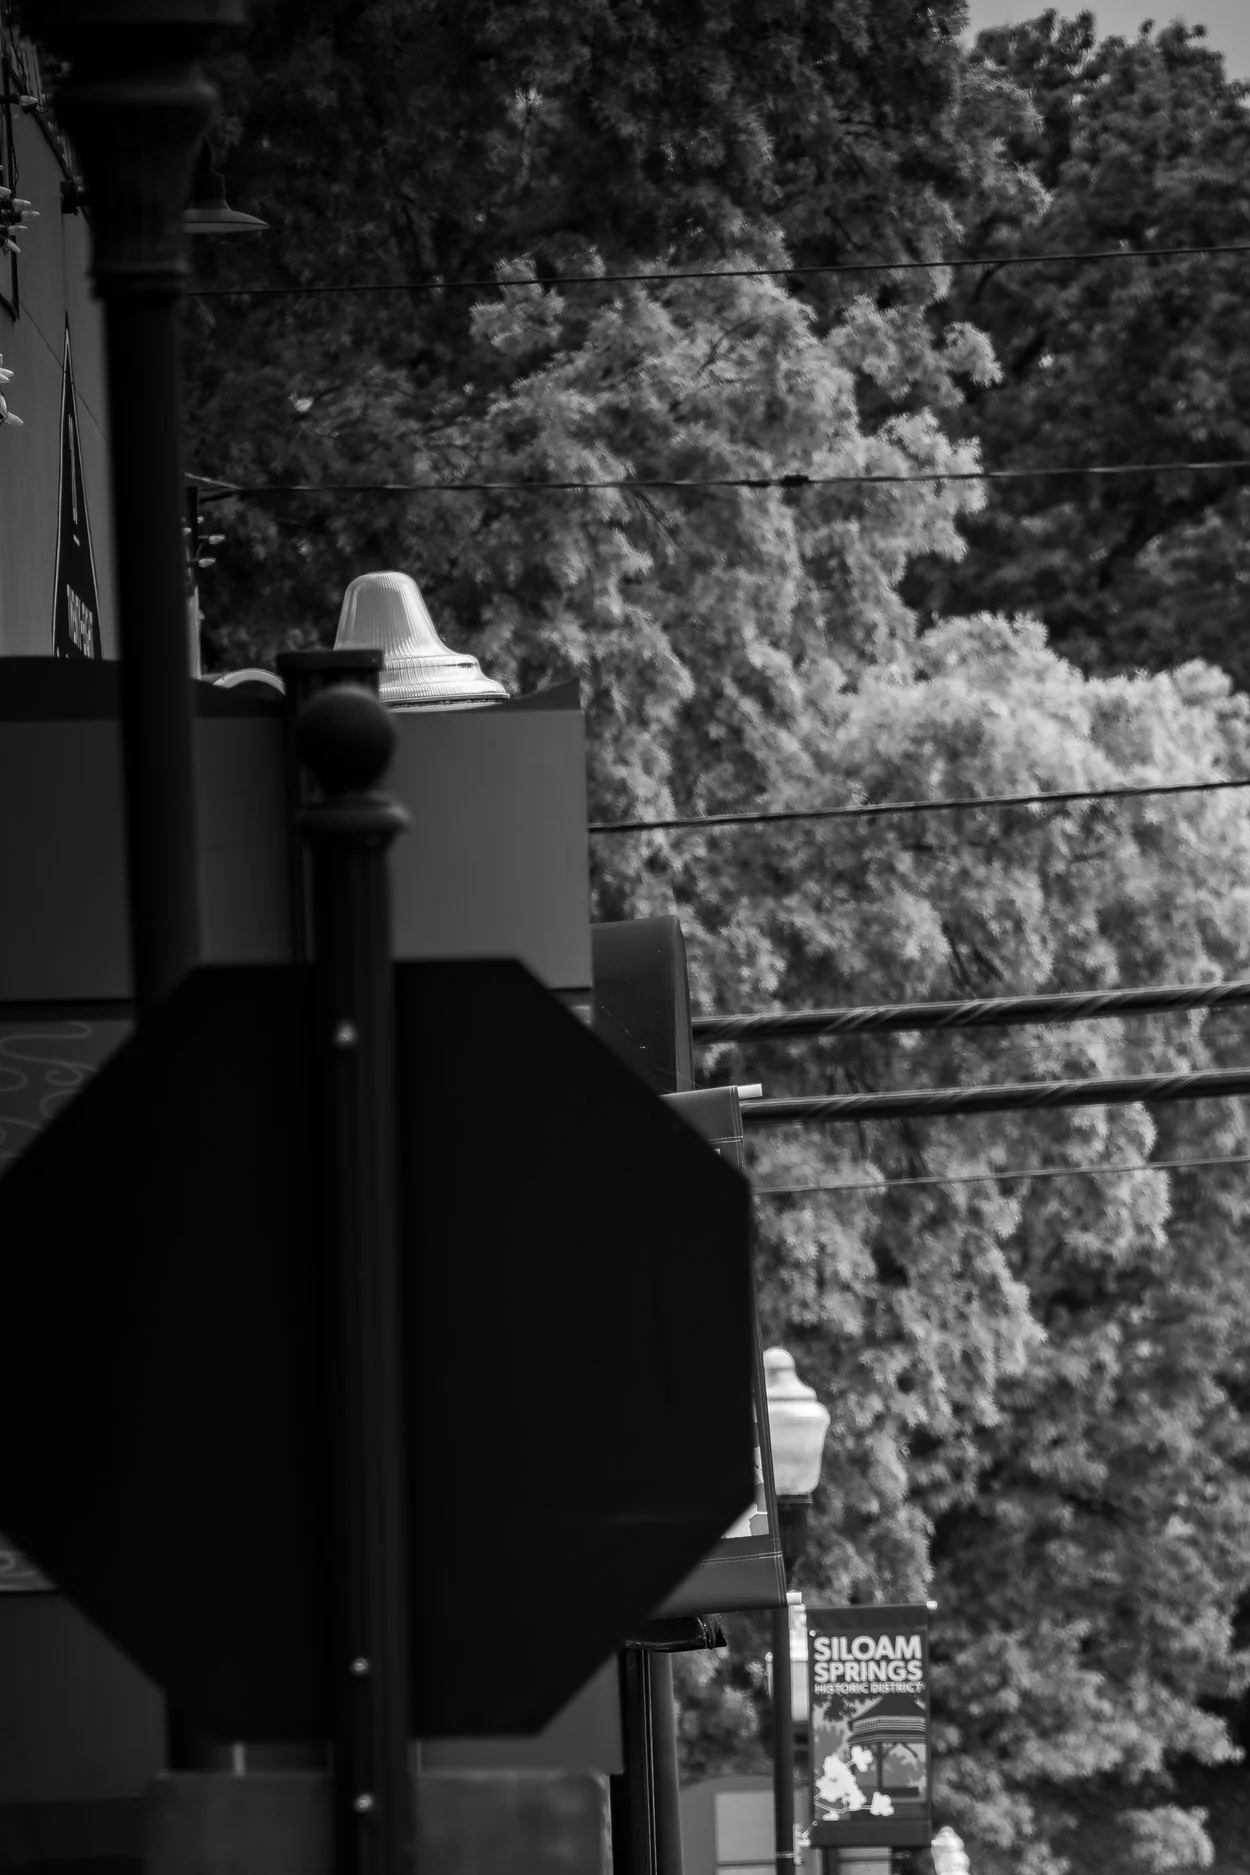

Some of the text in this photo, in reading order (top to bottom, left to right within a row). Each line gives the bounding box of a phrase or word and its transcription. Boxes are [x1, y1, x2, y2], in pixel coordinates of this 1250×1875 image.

[813, 1635, 922, 1661] SILOAM
[814, 1660, 923, 1683] SPRINGS
[815, 1681, 925, 1694] HISTORIC DISTRICT
